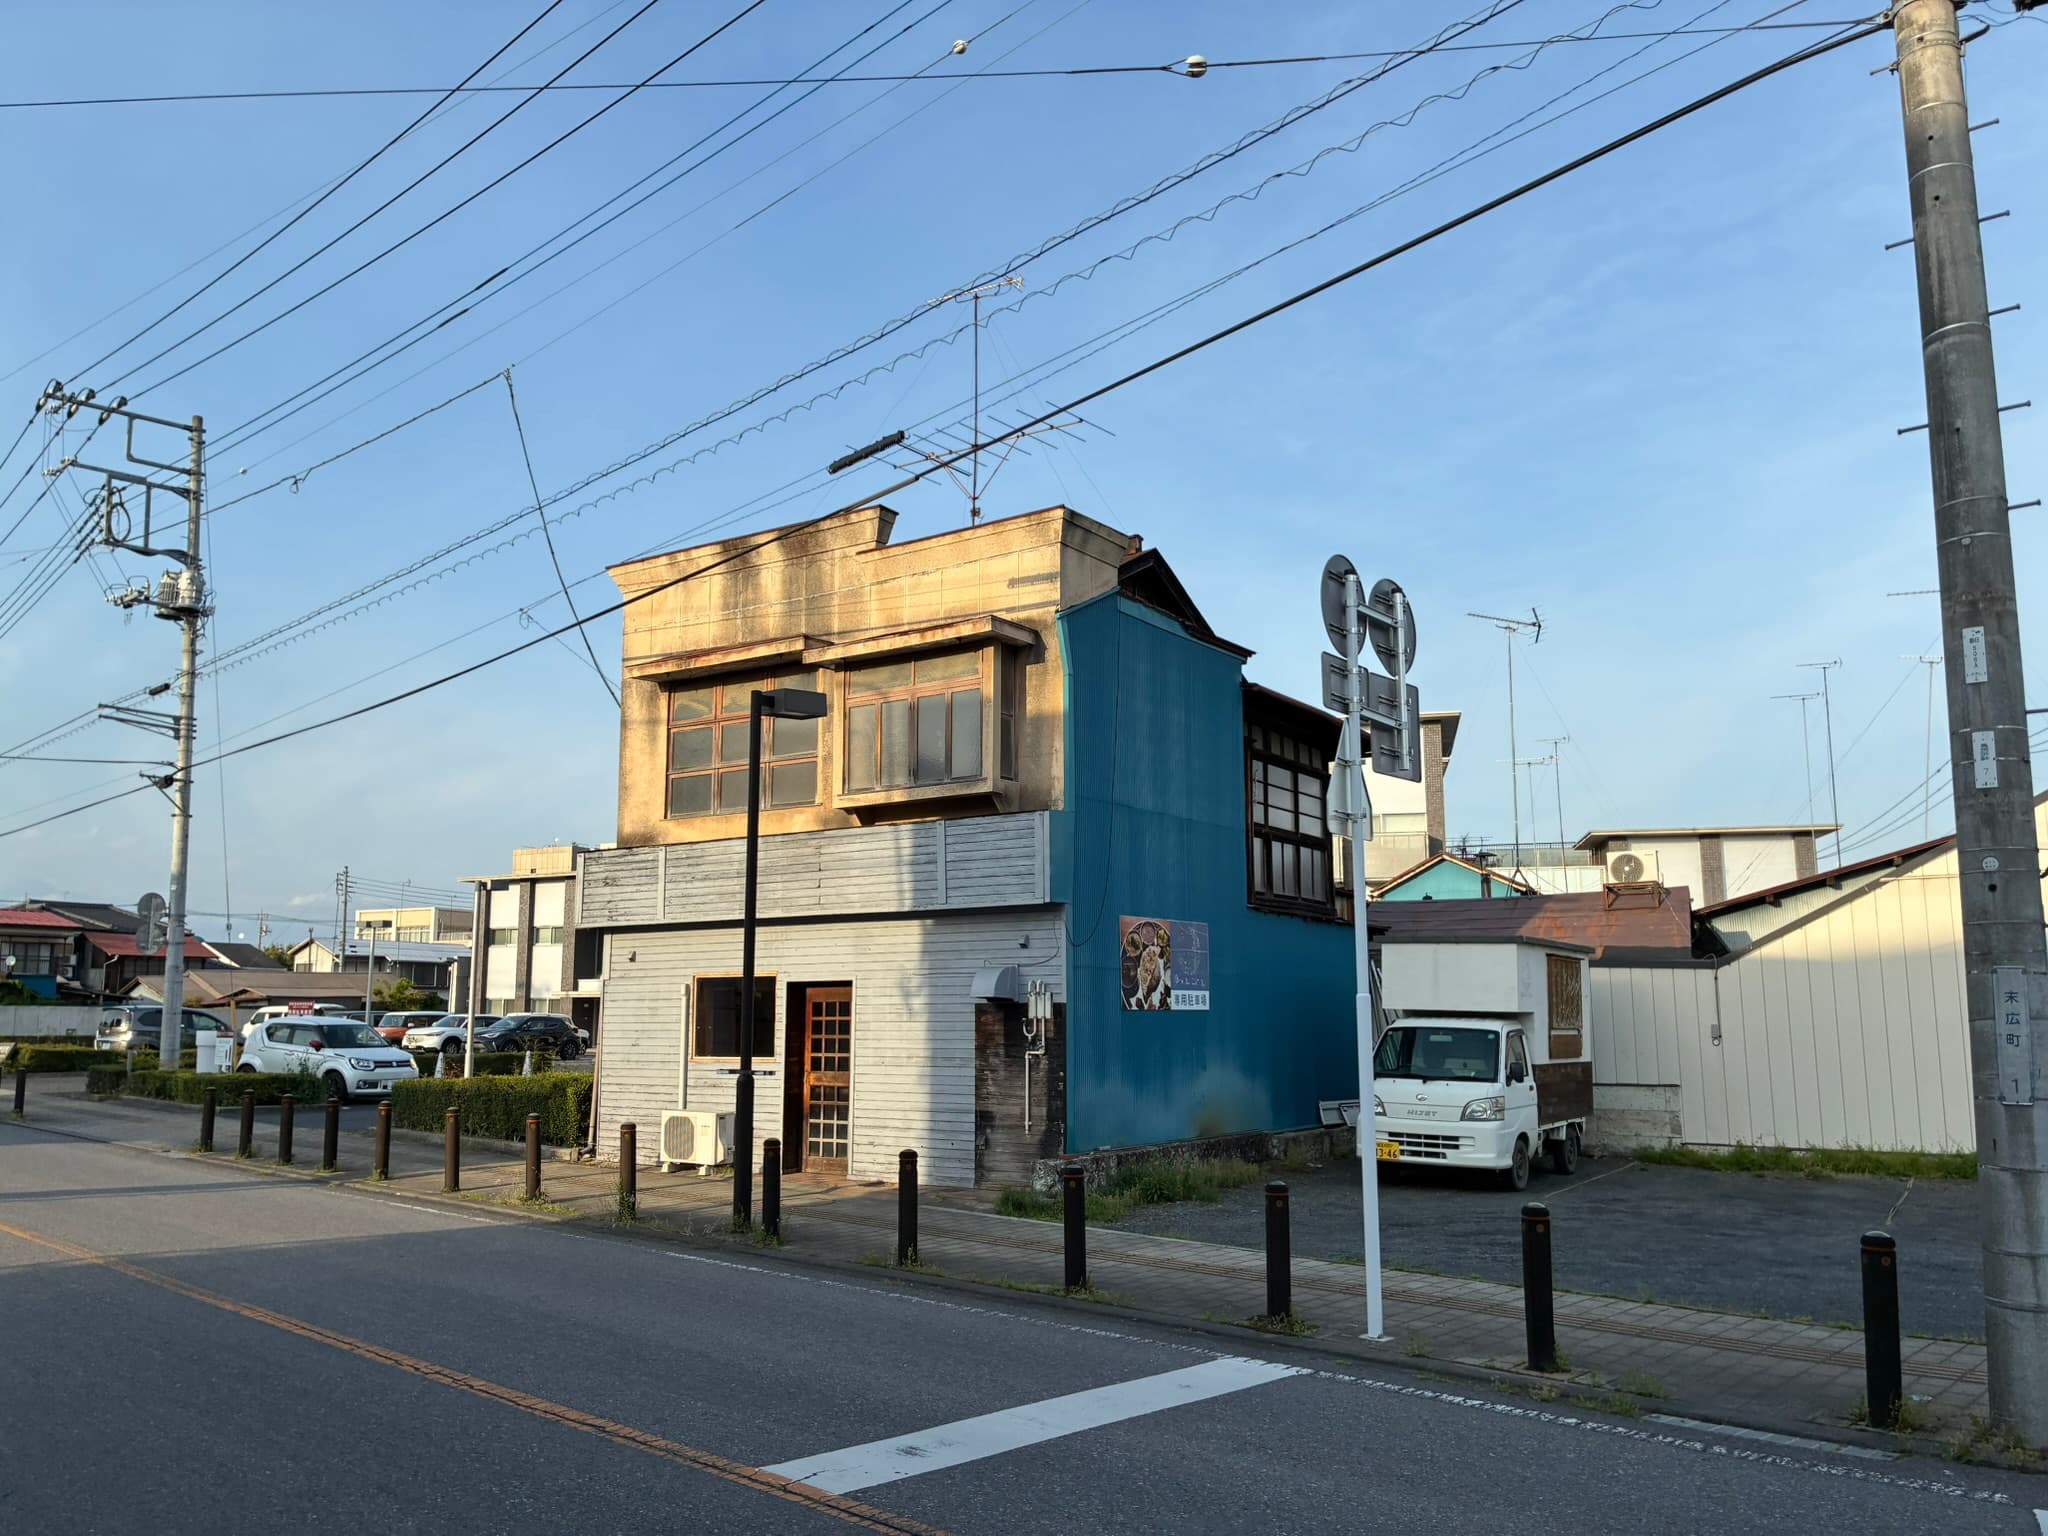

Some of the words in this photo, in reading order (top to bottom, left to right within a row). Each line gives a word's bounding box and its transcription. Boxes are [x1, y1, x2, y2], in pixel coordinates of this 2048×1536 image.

[2004, 991, 2021, 1047] 末広町
[2011, 1078, 2019, 1094] 1
